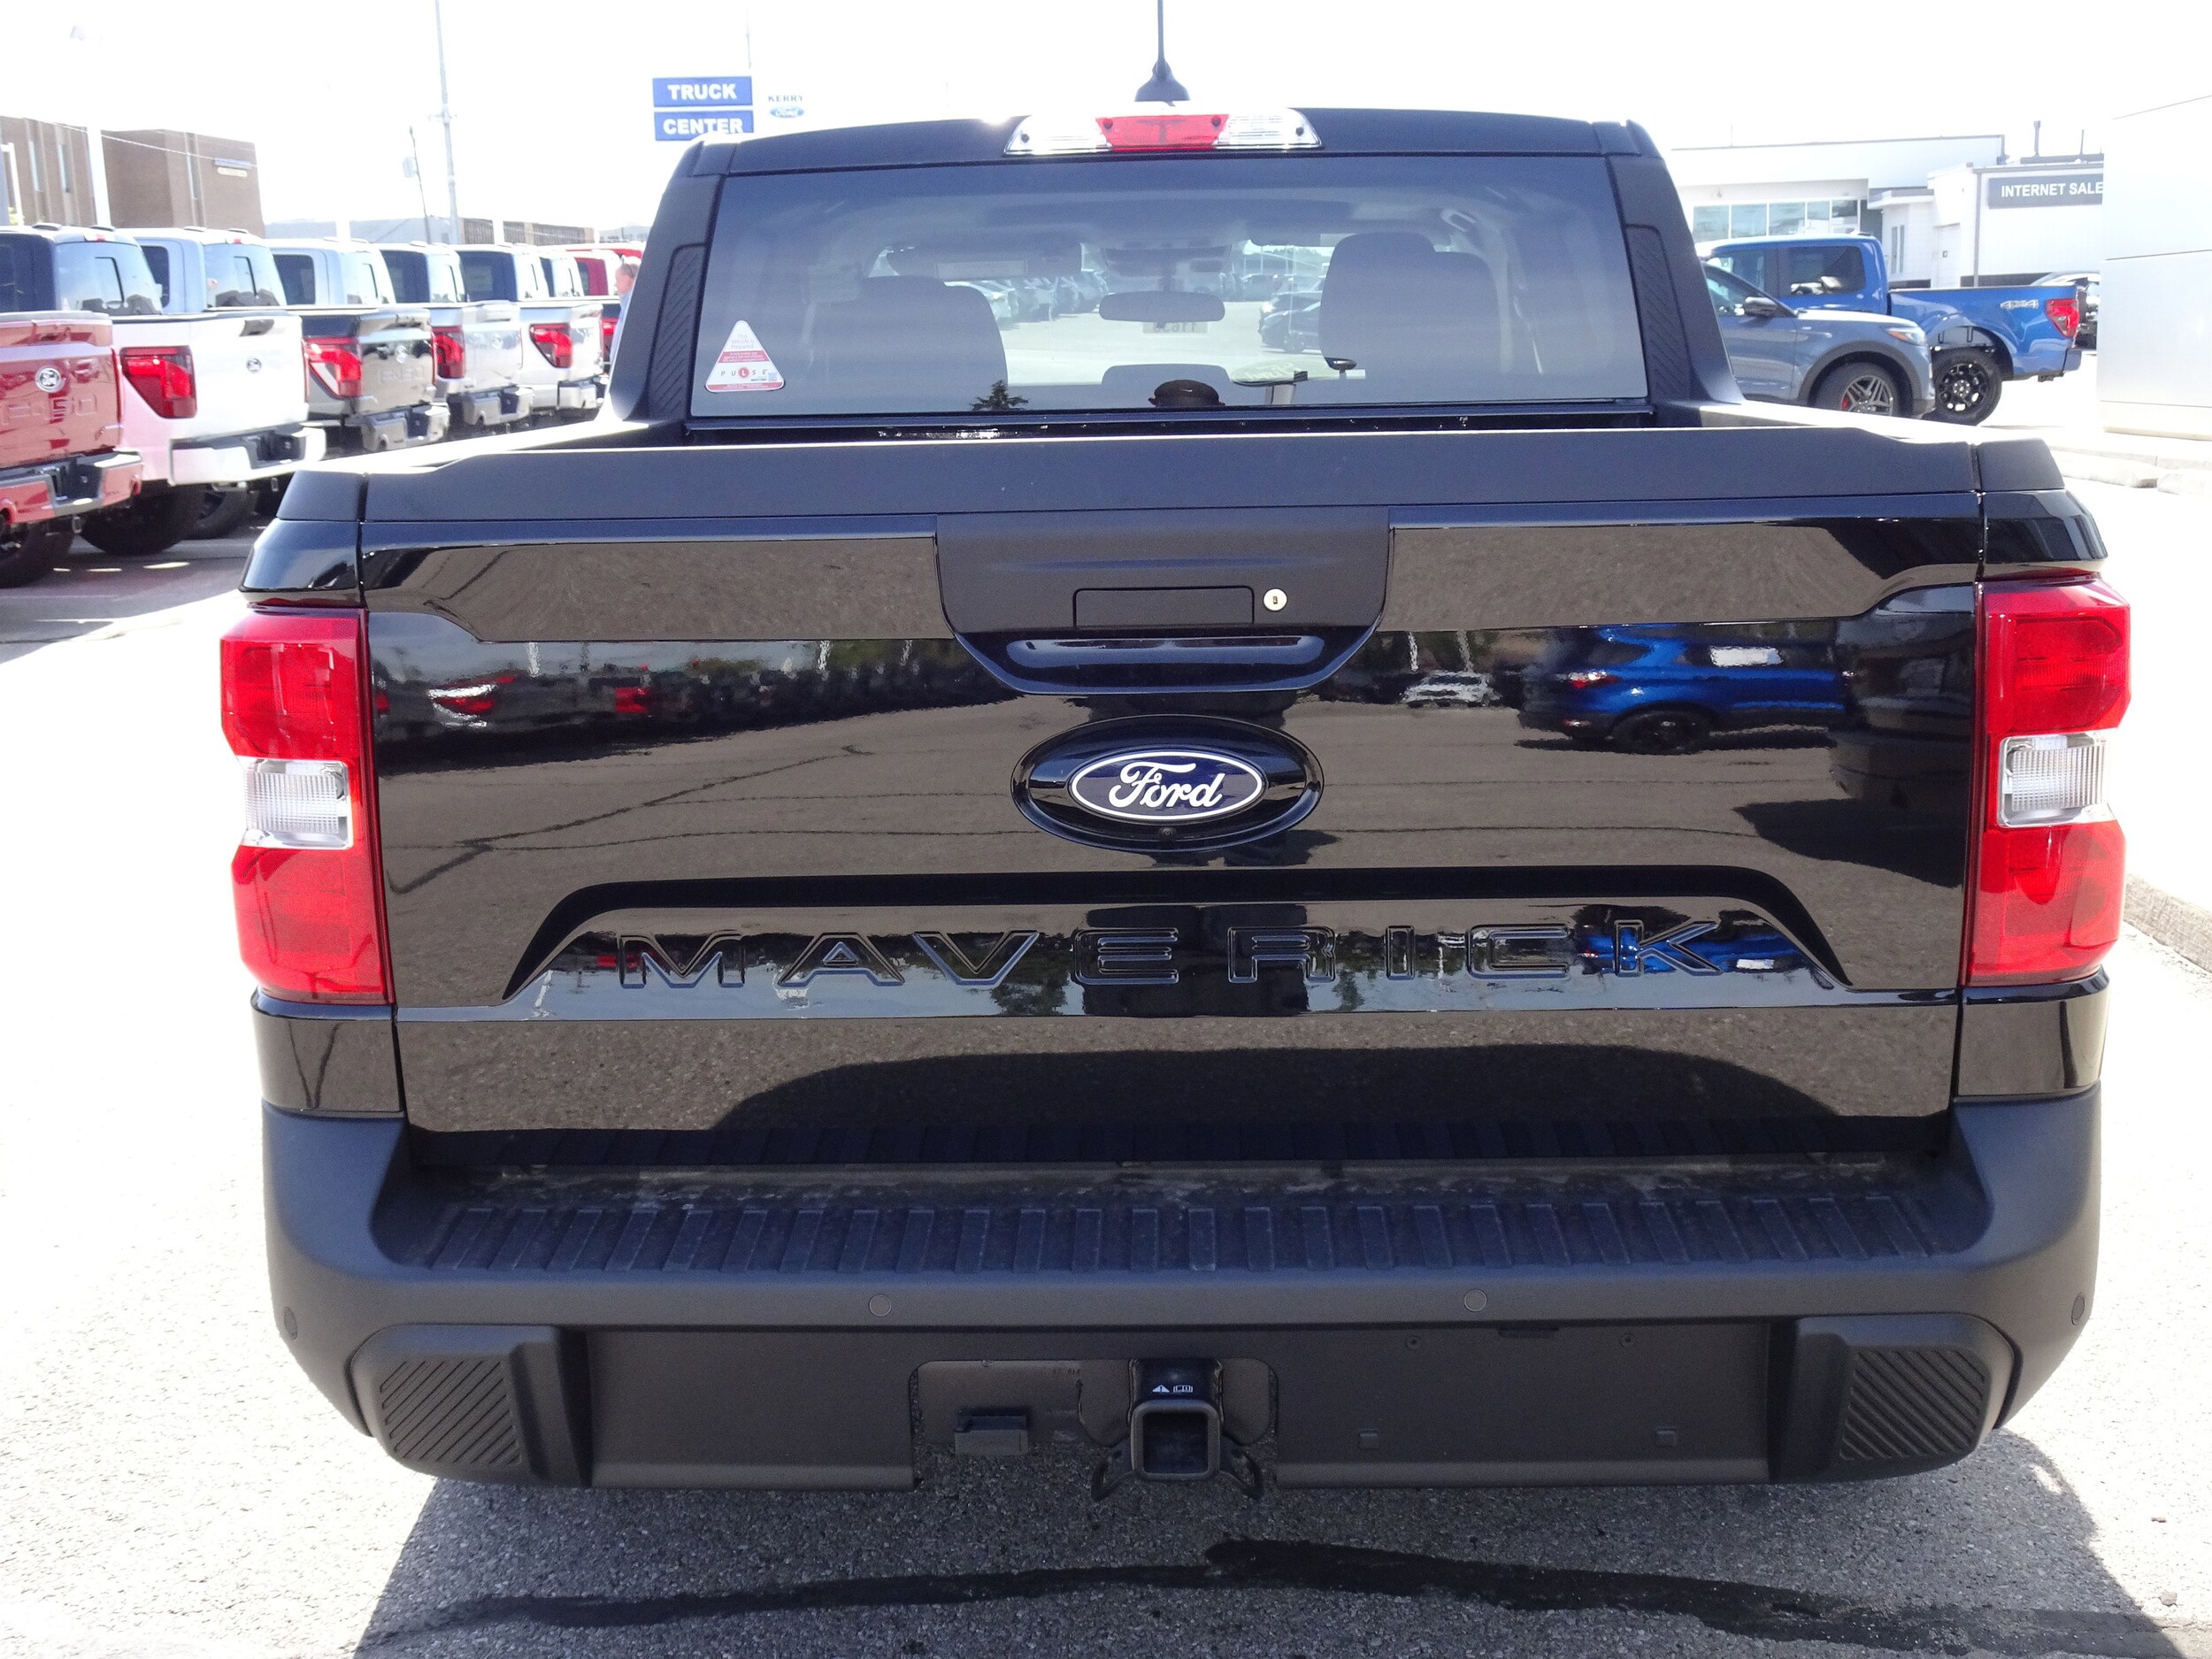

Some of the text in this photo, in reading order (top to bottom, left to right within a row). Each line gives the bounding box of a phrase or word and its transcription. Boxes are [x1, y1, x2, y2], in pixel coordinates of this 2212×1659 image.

[667, 83, 737, 100] TRUCK
[663, 118, 743, 134] CENTER
[2001, 182, 2066, 197] INTERNET
[1109, 762, 1225, 807] Ford
[618, 919, 1722, 987] MAVERICK
